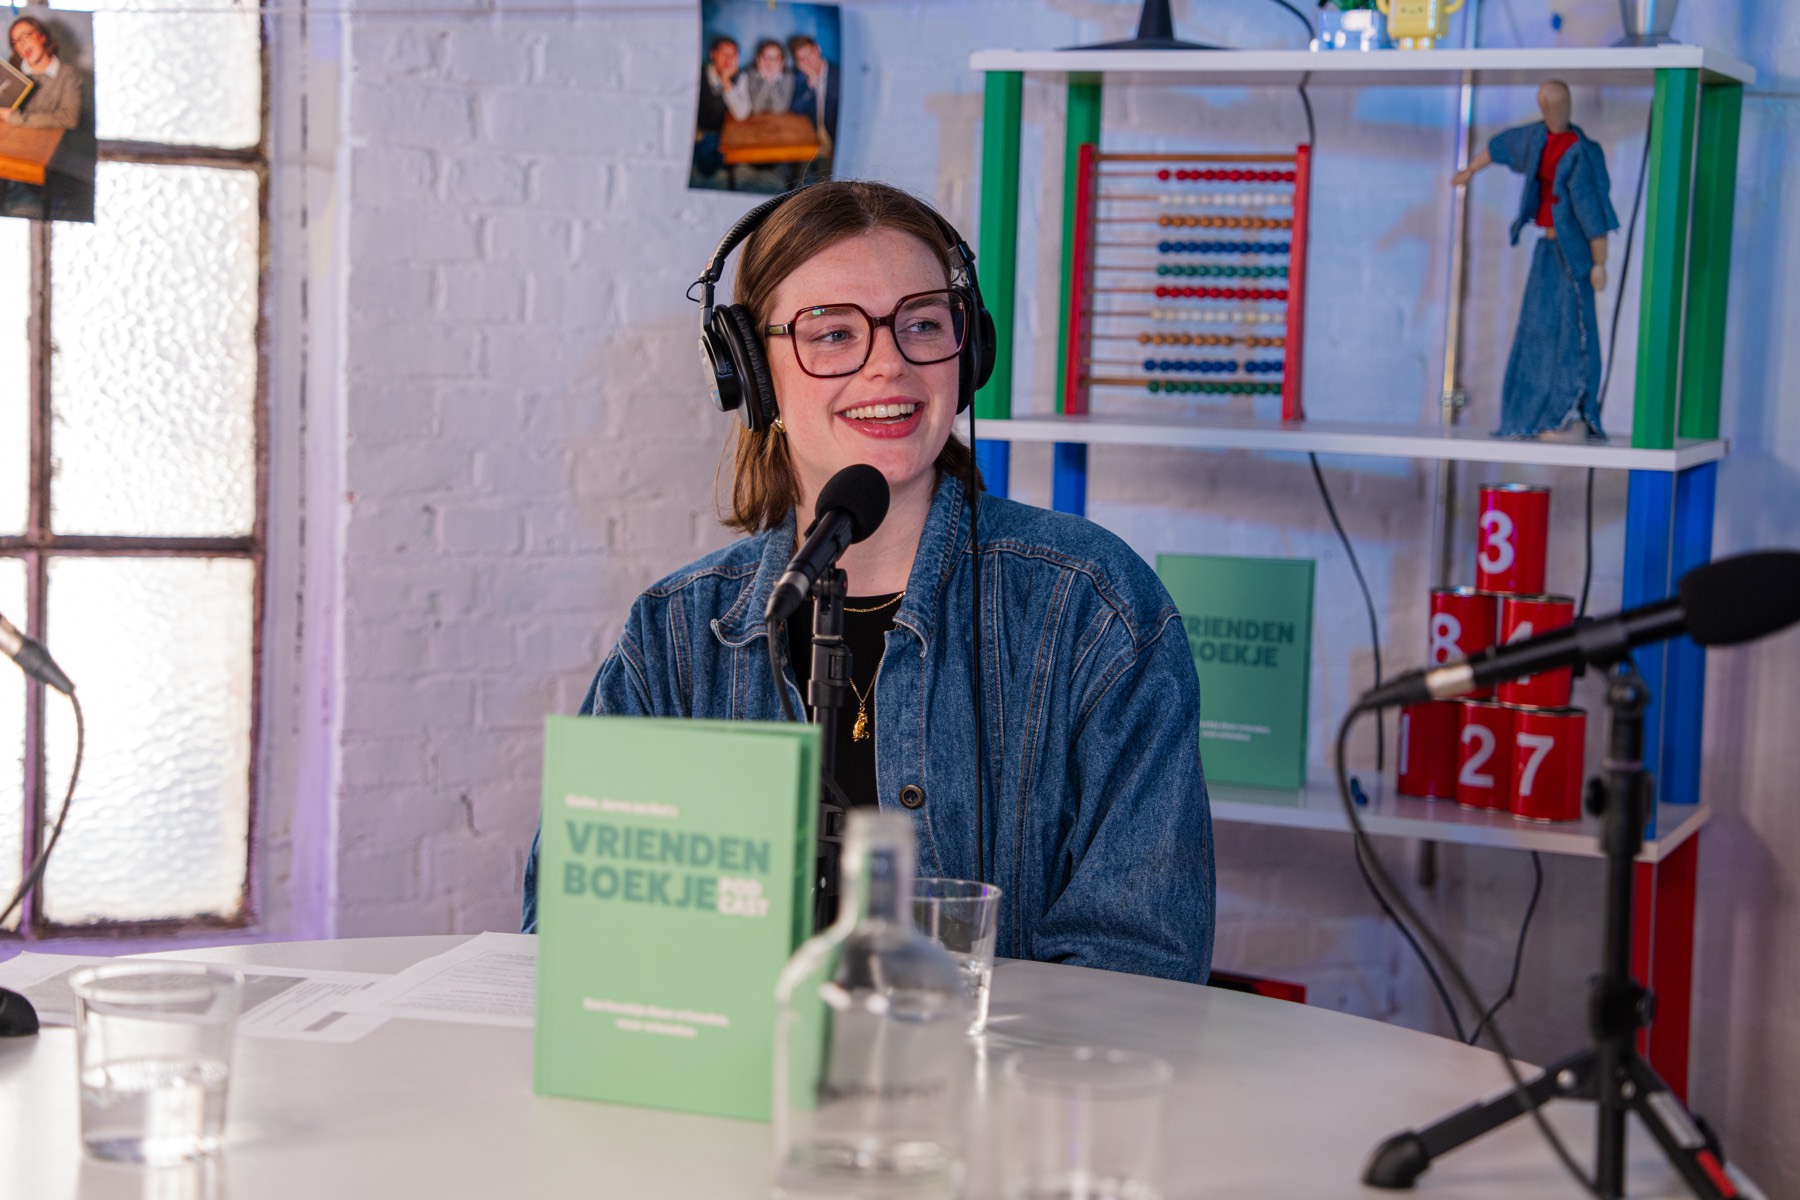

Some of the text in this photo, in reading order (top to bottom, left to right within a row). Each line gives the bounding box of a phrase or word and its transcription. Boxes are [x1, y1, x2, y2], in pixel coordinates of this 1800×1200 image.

[1479, 510, 1516, 574] 3
[1431, 612, 1464, 668] 8
[1458, 723, 1496, 788] 2
[1516, 732, 1555, 797] 7
[565, 820, 771, 875] VRIENDEN
[564, 861, 718, 912] BOEKJE
